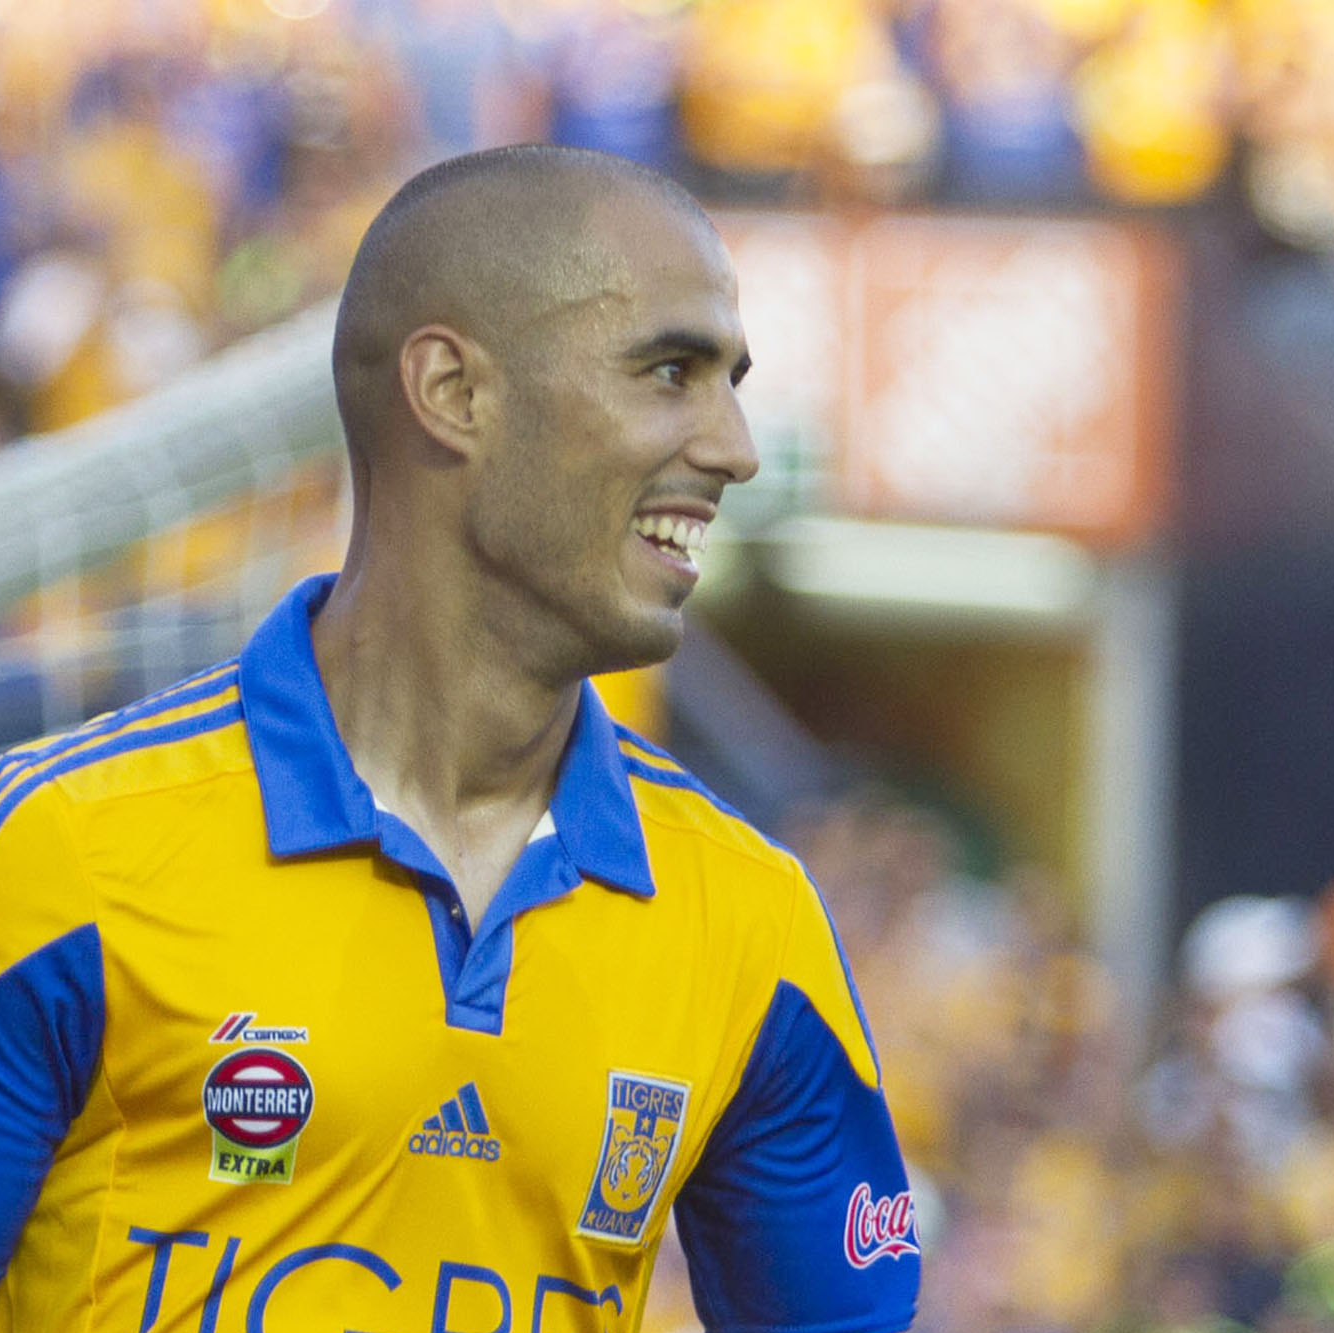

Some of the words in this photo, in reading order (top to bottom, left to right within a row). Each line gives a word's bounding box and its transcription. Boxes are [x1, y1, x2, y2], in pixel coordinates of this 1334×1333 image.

[207, 1087, 310, 1114] MONTERREY
[614, 1079, 683, 1119] TIGRES
[408, 1130, 500, 1162] adidas
[218, 1153, 286, 1176] EXTRA
